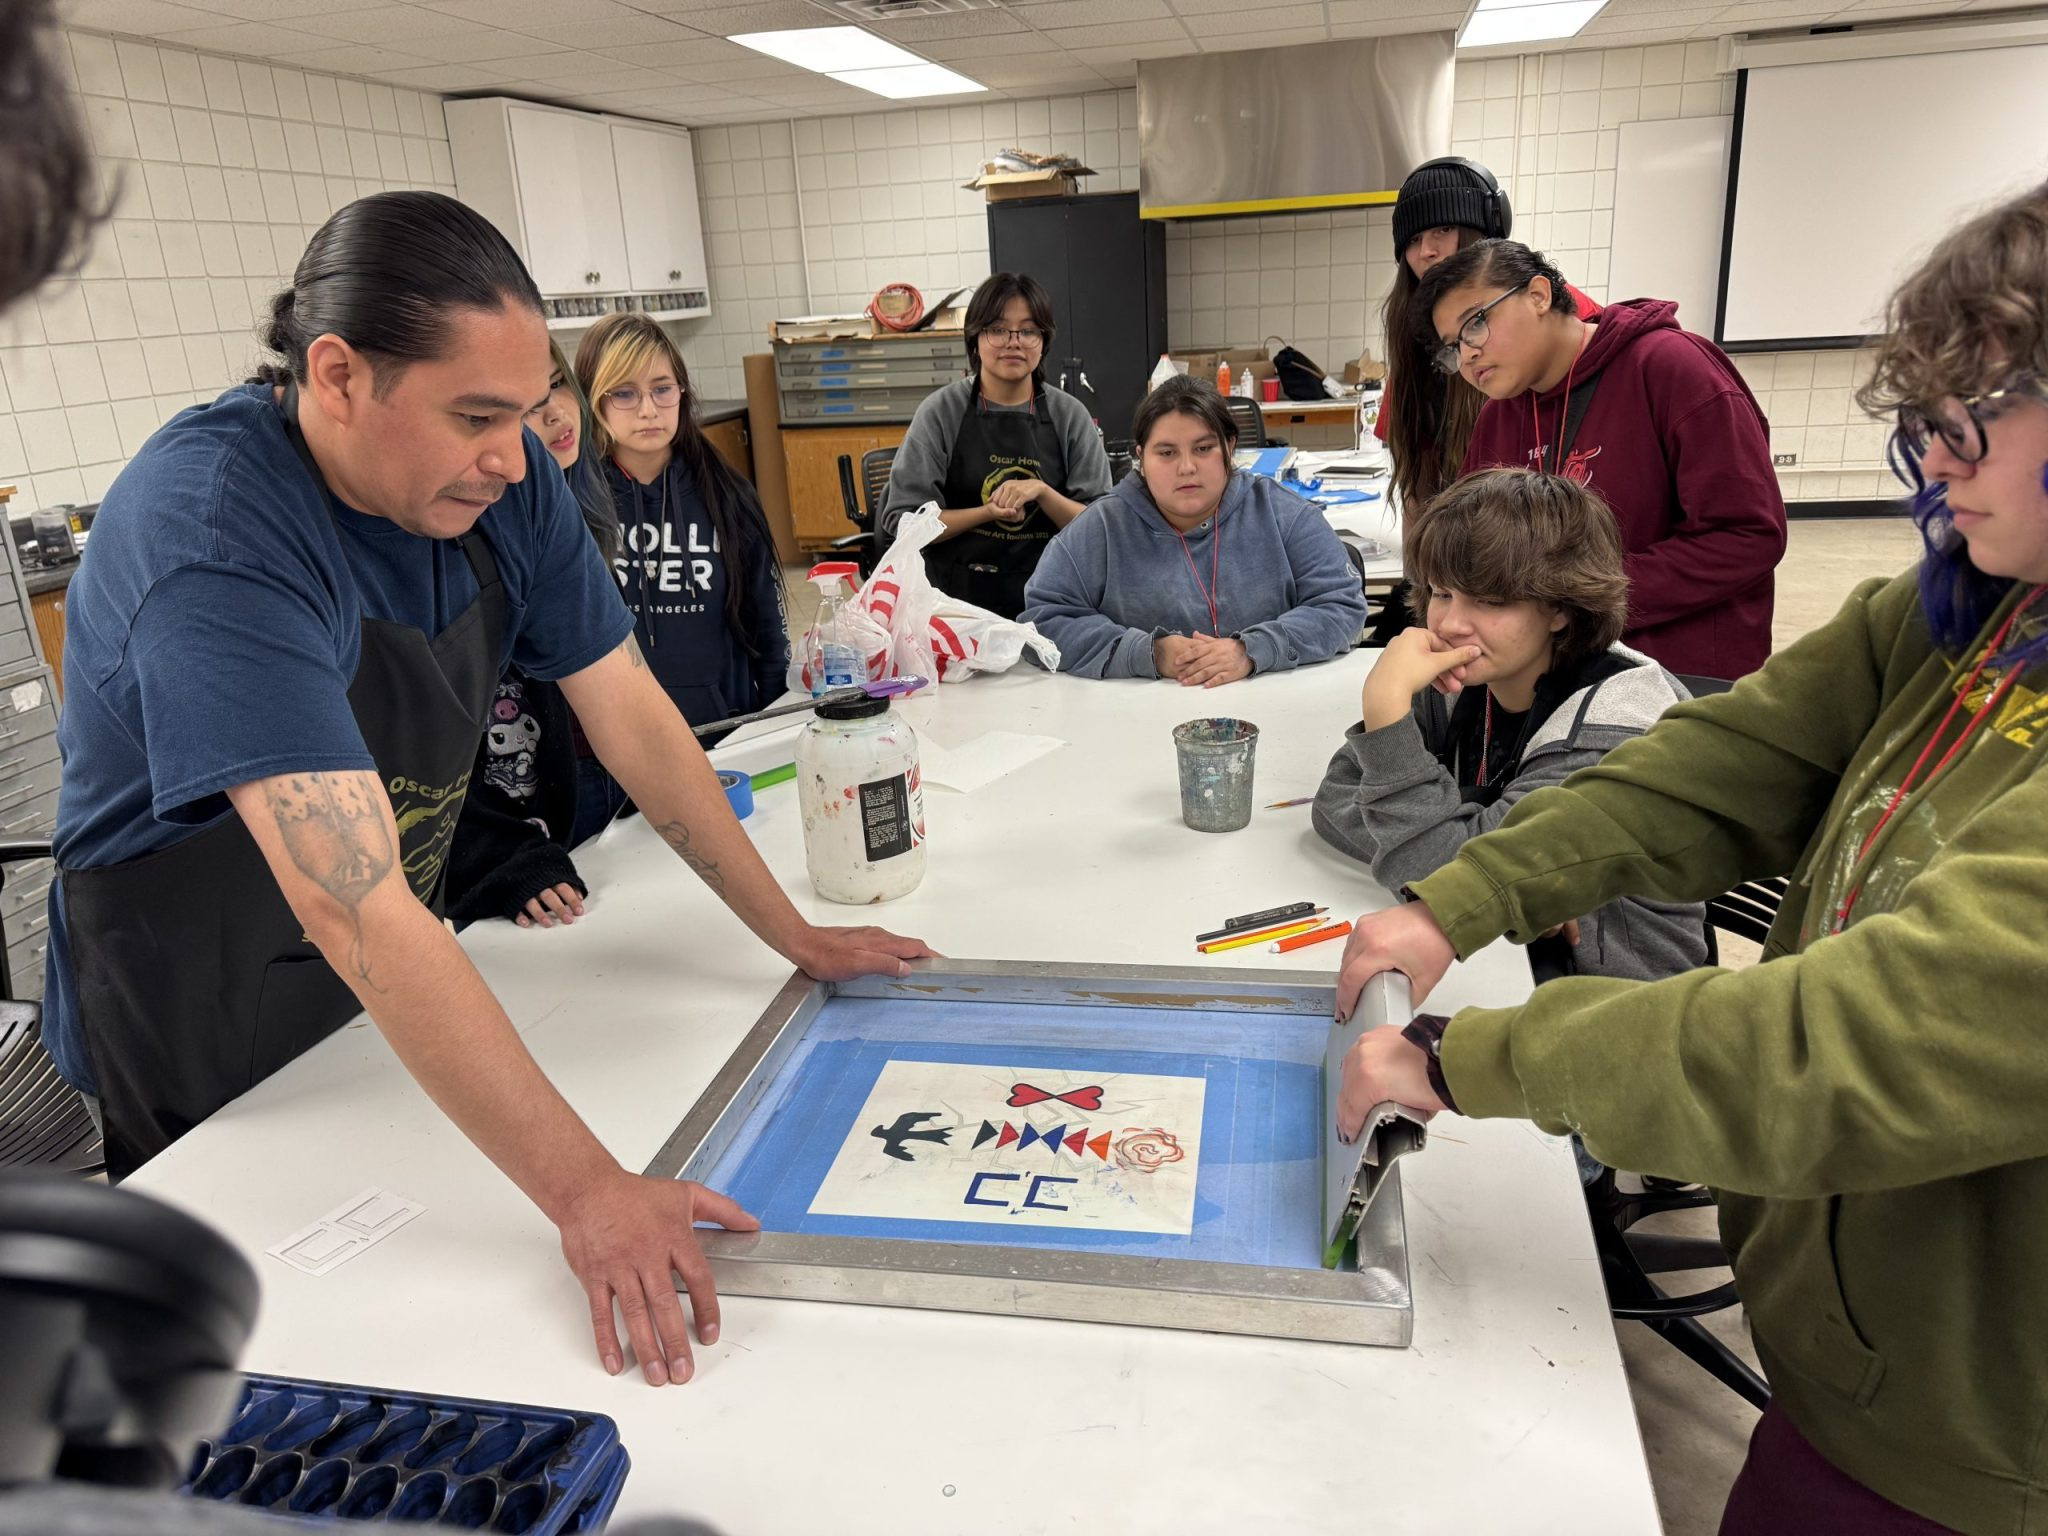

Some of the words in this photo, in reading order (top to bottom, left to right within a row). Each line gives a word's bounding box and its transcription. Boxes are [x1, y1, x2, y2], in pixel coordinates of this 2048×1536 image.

[989, 454, 1015, 464] Oscar
[1018, 456, 1041, 467] How
[389, 776, 453, 800] Oscar
